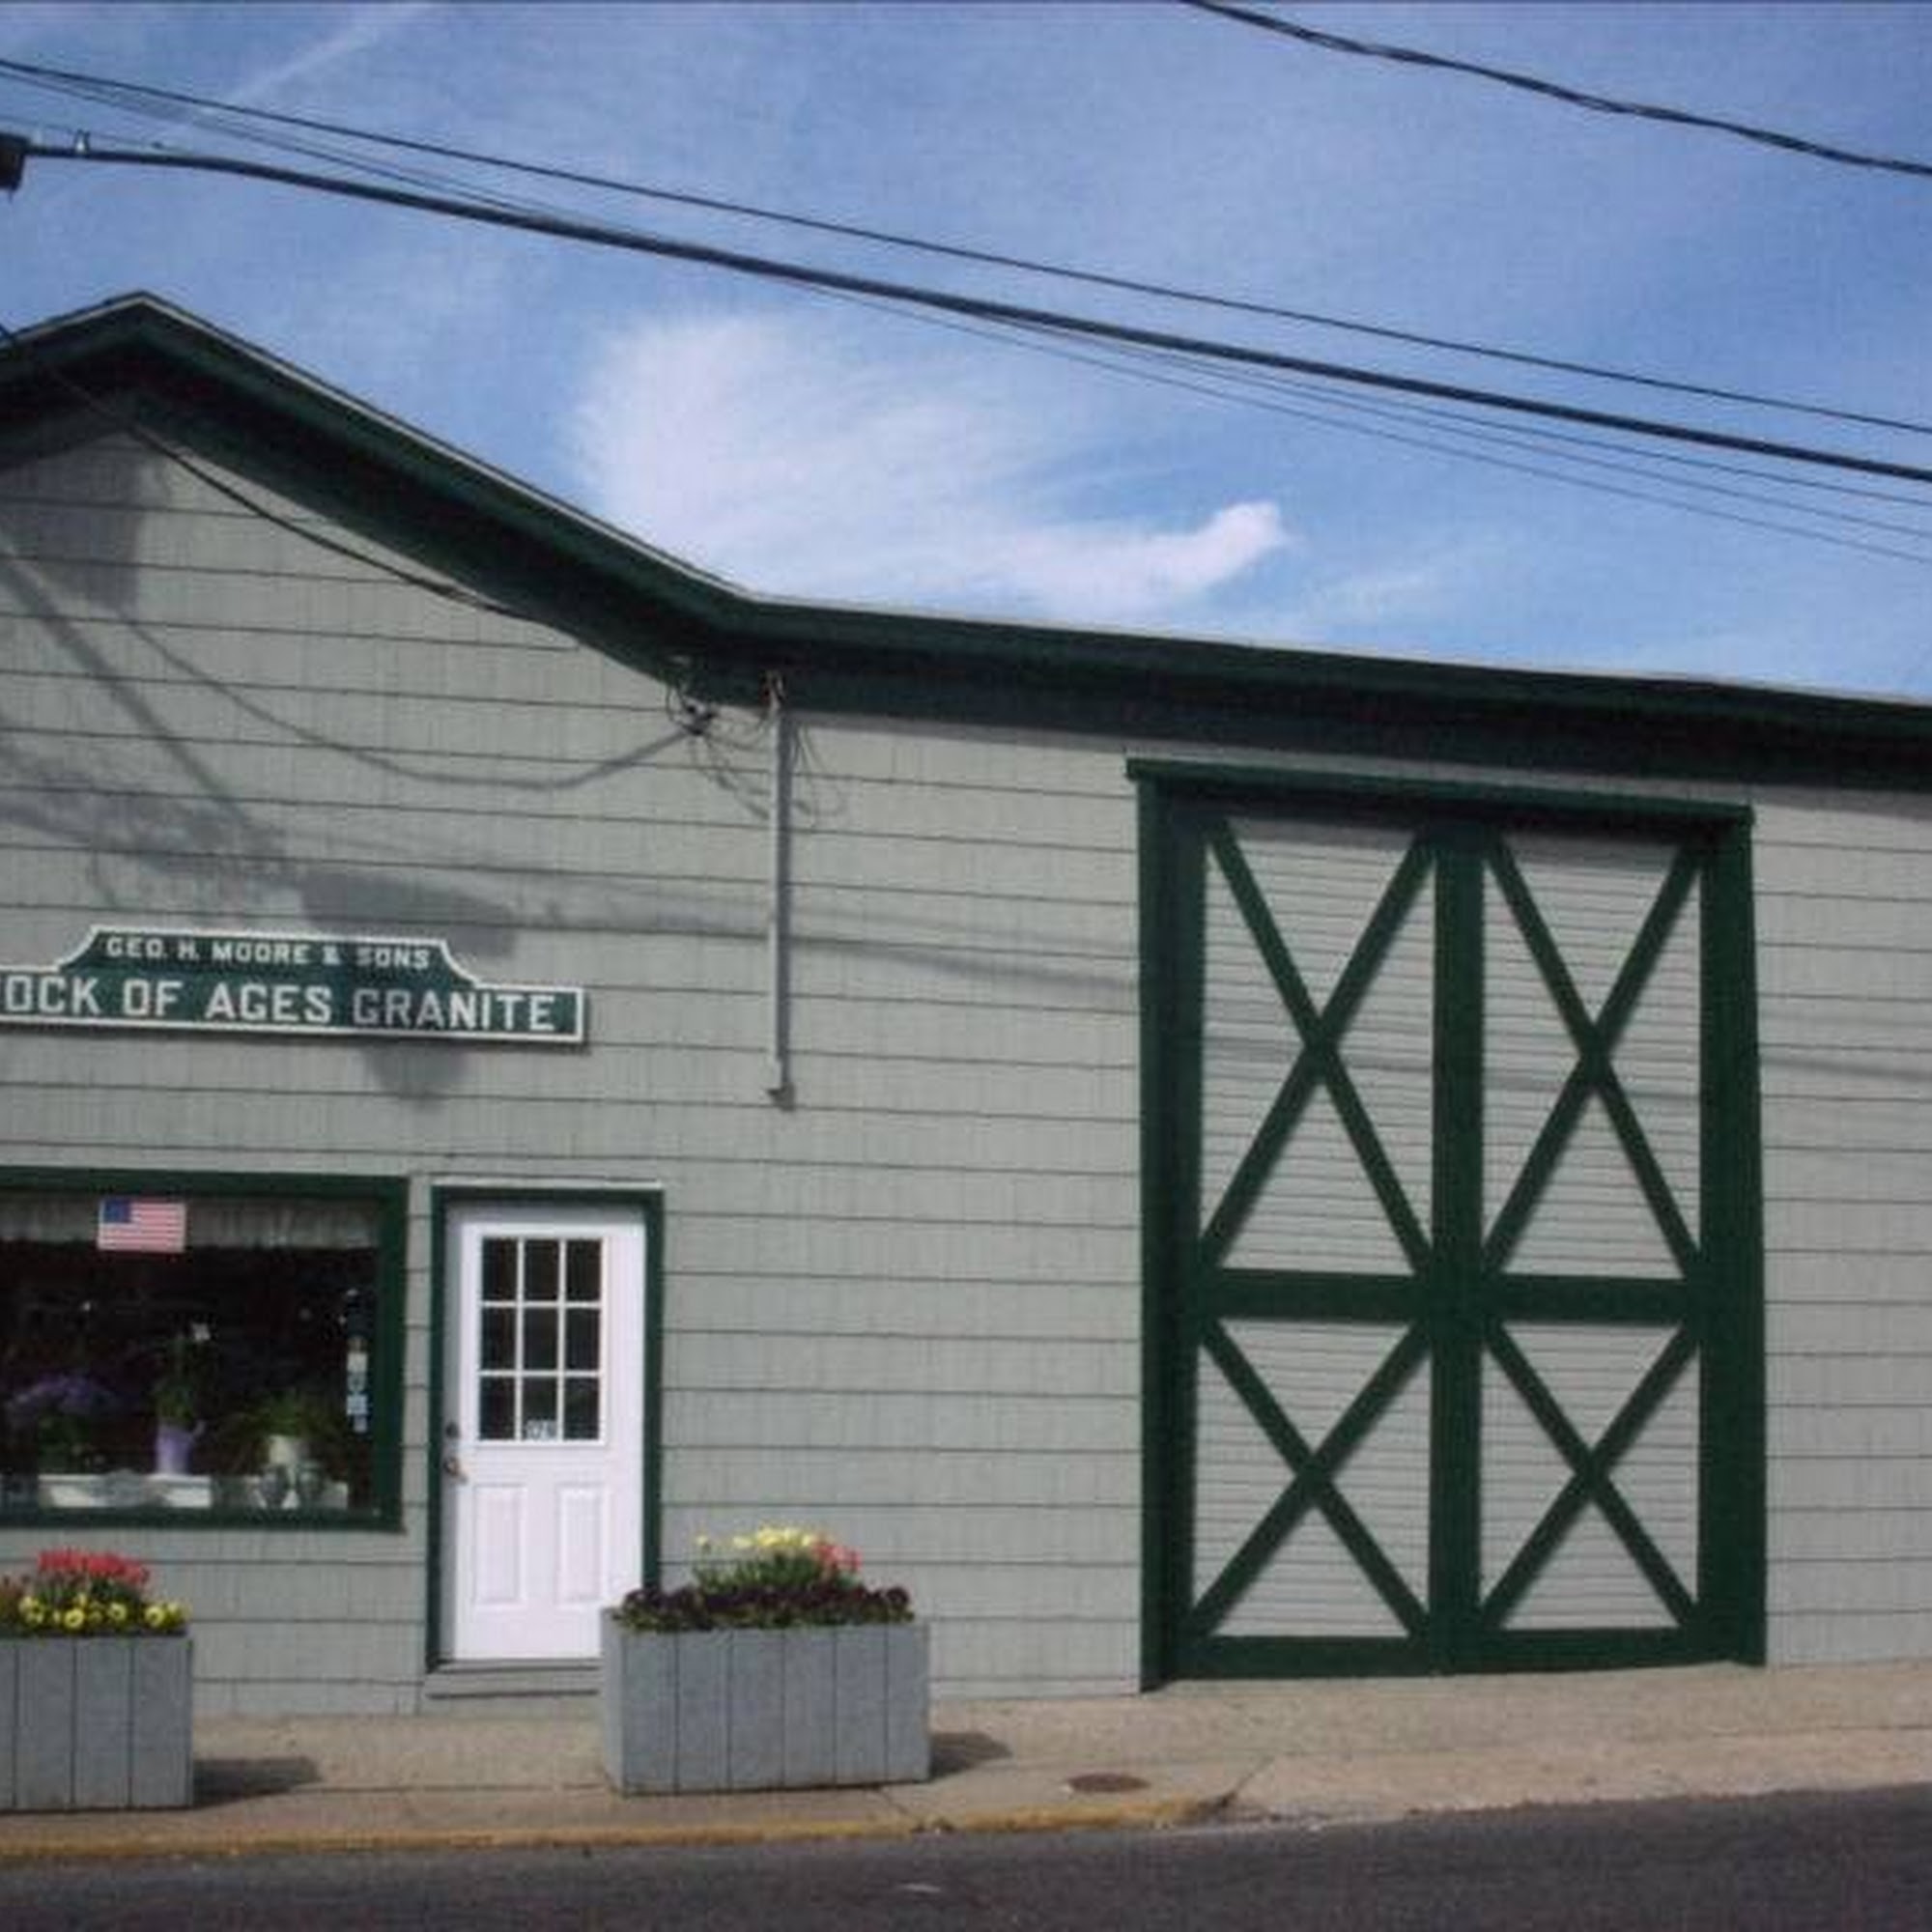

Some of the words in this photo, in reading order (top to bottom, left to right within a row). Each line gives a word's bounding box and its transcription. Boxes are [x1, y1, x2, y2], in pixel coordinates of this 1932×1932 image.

[212, 941, 308, 964] MOORE
[355, 947, 431, 970] SONS
[123, 978, 183, 1016] OF
[204, 981, 333, 1024] AGES
[352, 988, 556, 1032] GRANITE
